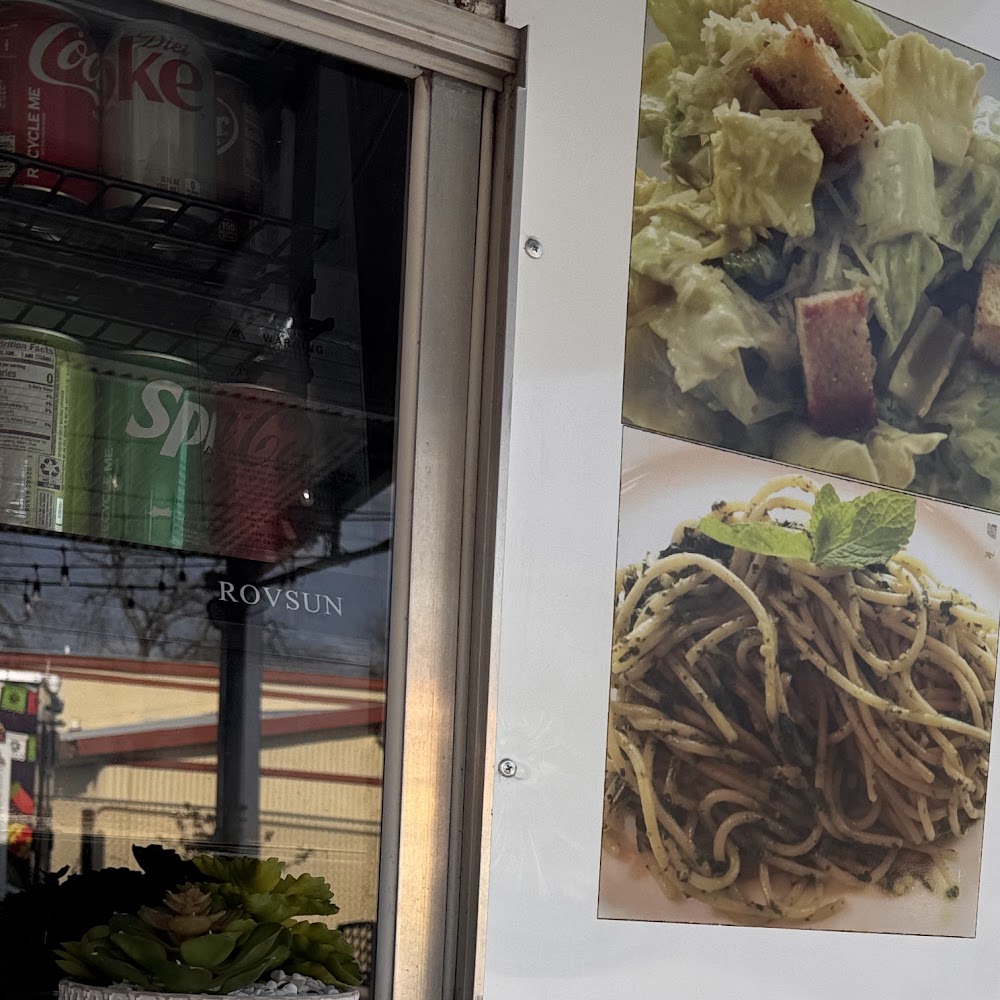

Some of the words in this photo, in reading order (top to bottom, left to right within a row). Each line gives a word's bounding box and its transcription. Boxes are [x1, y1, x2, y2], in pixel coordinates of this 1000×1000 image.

[28, 87, 41, 112] ME
[27, 113, 40, 178] RCYCLE
[29, 344, 54, 355] Facts
[263, 332, 324, 355] WARNG
[104, 447, 114, 472] ME
[218, 580, 343, 617] ROVSUN
